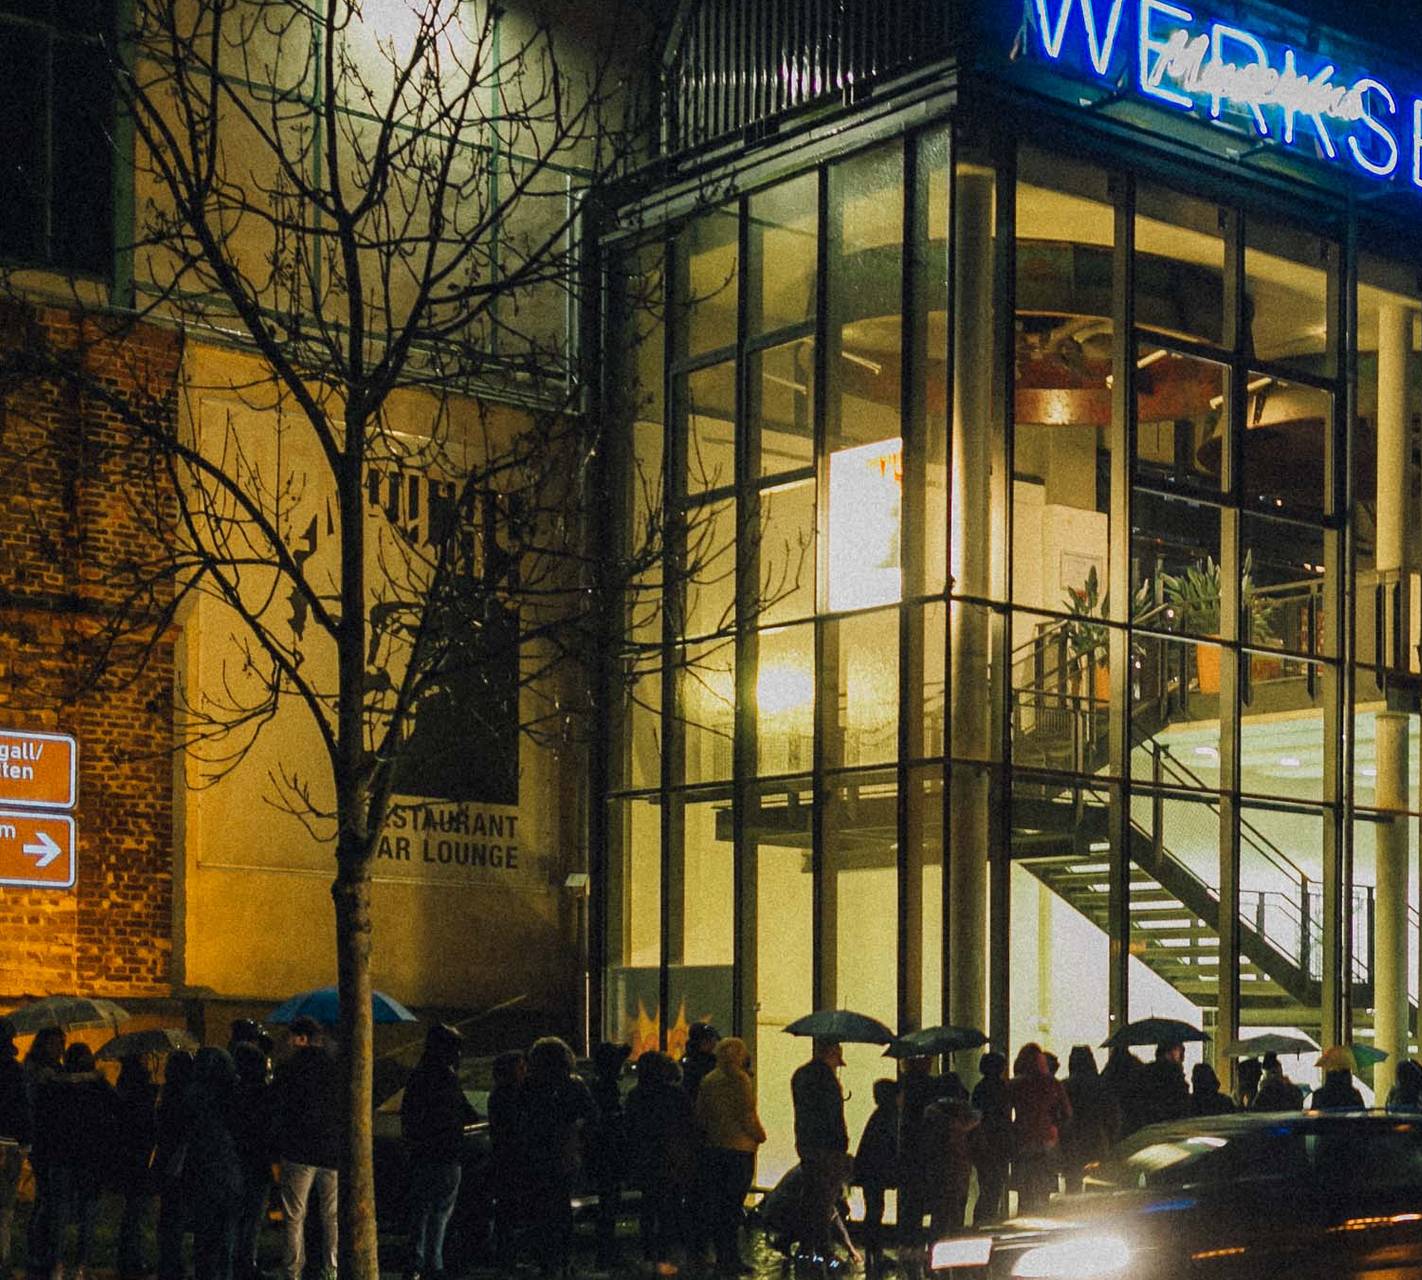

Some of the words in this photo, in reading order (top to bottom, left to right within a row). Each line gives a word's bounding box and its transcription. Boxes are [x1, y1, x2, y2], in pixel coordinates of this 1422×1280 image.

[0, 762, 34, 780] ten
[377, 836, 410, 861] AR
[423, 838, 519, 870] LOUNGE
